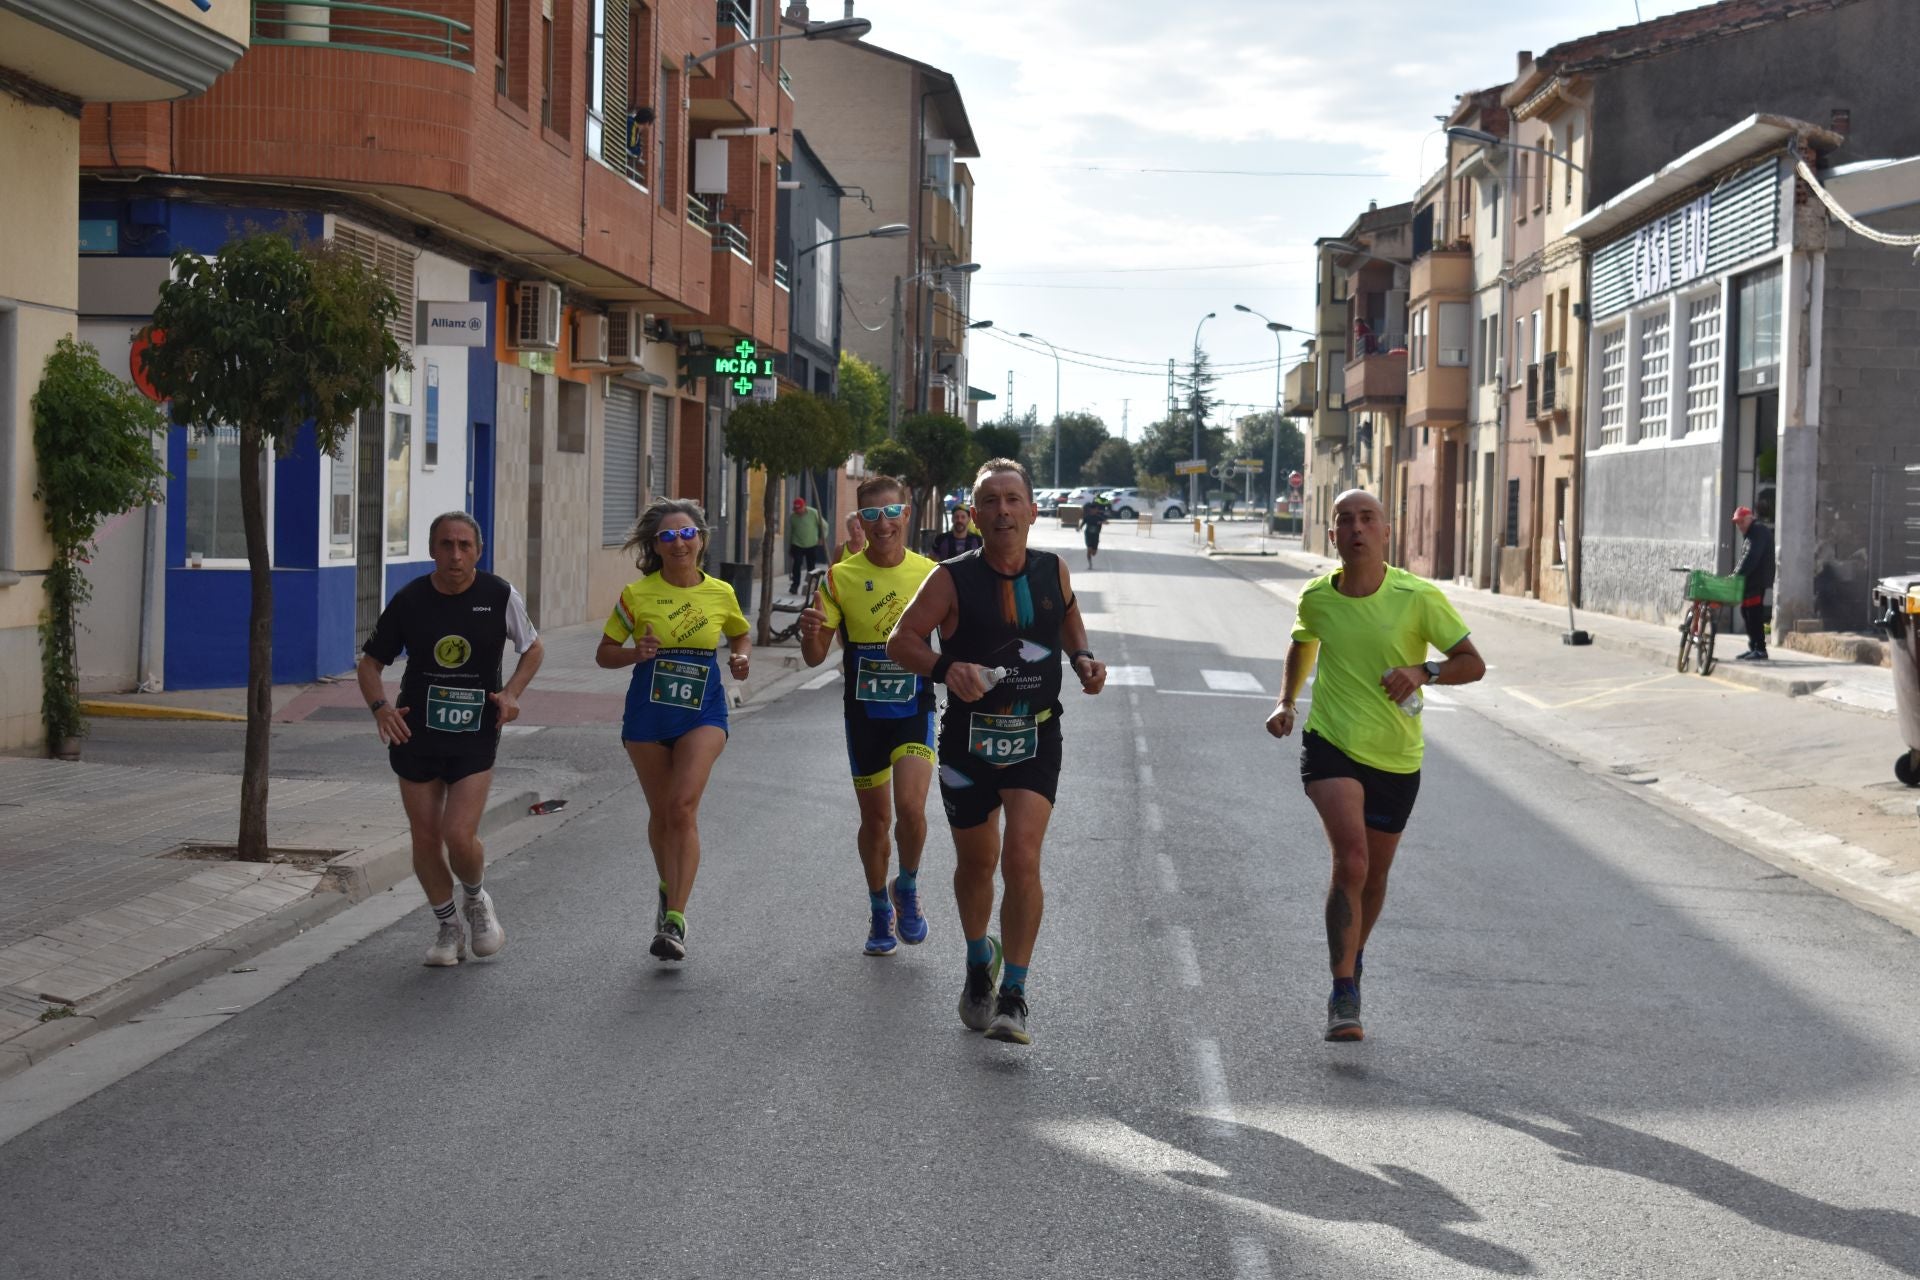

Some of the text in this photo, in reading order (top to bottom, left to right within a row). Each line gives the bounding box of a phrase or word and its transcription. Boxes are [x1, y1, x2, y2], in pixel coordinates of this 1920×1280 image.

[1633, 214, 1672, 301] CASA
[431, 318, 466, 328] Allianz
[668, 601, 692, 621] RINCON
[870, 590, 897, 615] RINCON
[677, 618, 709, 643] ATLETISMO
[868, 678, 906, 694] 177
[1006, 675, 1042, 684] DEMANDA
[668, 681, 693, 700] 16
[436, 707, 474, 725] 109
[916, 750, 931, 759] SOTO
[981, 736, 1026, 757] 192
